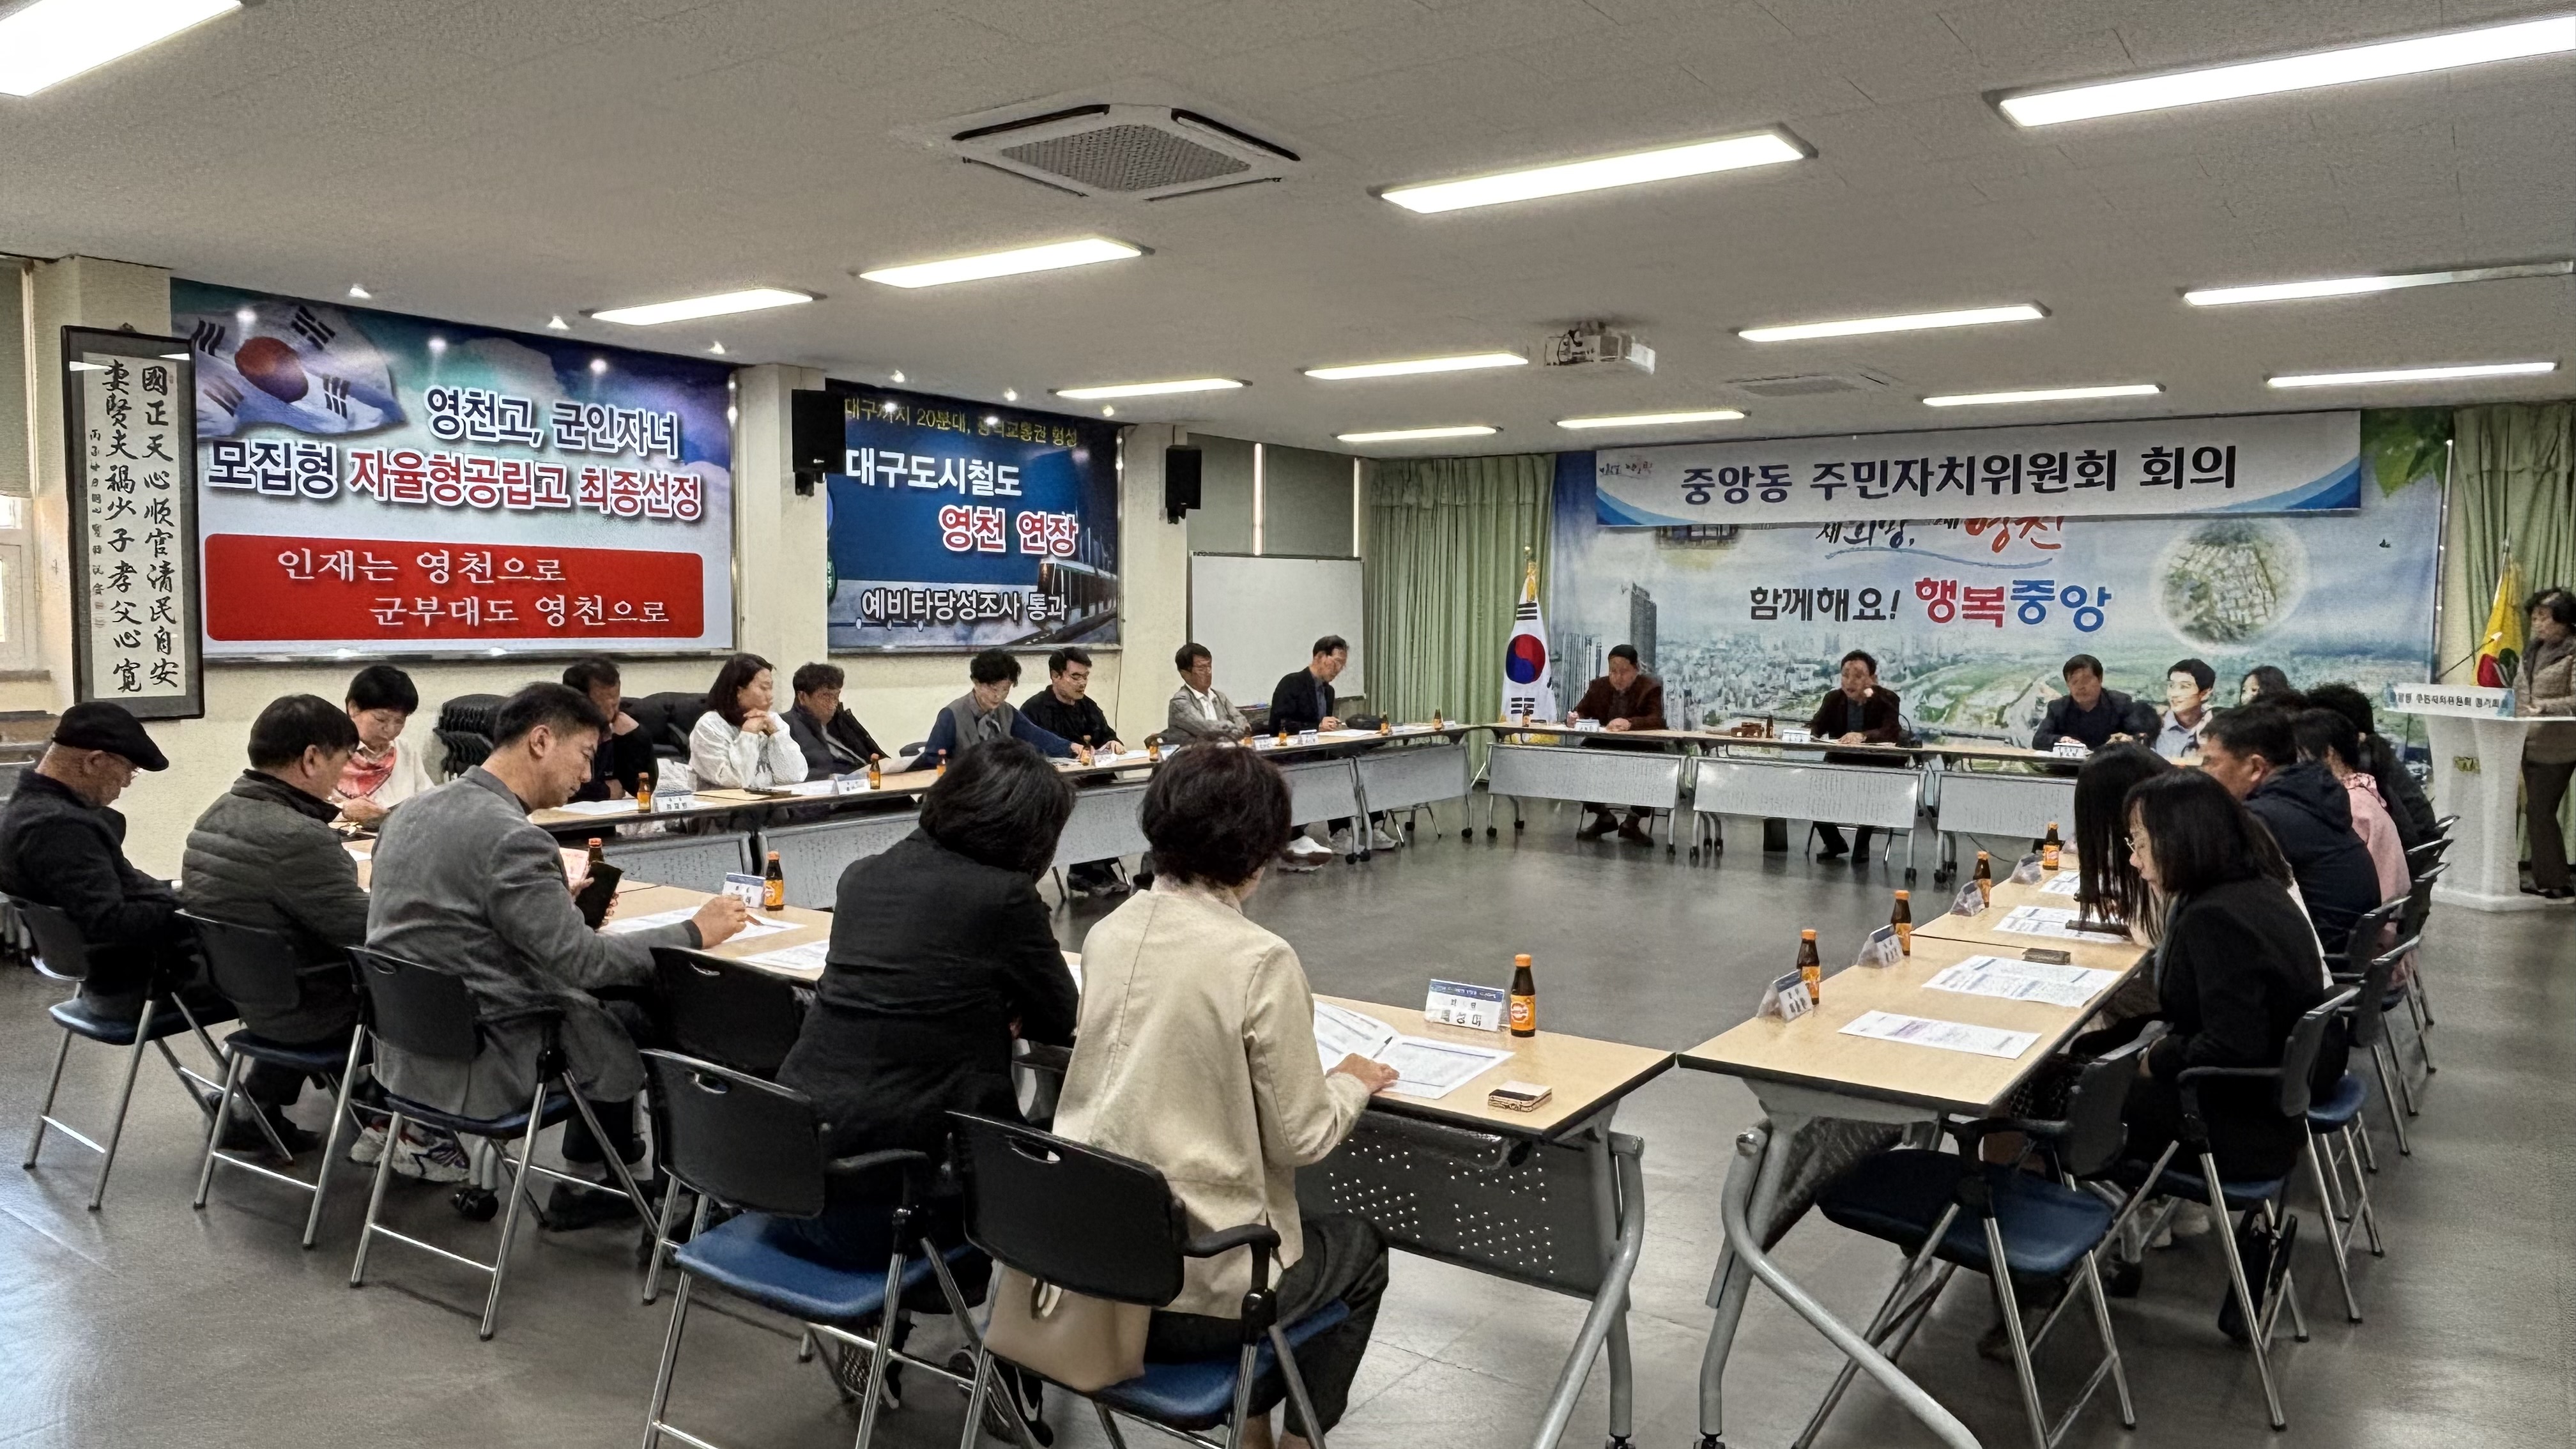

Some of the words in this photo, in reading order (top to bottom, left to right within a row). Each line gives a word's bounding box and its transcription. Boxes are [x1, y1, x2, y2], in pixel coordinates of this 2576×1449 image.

[427, 386, 542, 448] 영천고,
[551, 399, 678, 459] 군인자녀
[206, 440, 337, 498] 모집형
[348, 448, 570, 509] 자율형공립고
[578, 466, 703, 520] 최종선정
[846, 448, 1022, 496] 대구도시철도
[1681, 464, 1793, 505] 중앙동
[1810, 449, 2117, 500] 주민자치위원회
[2140, 445, 2236, 489] 회의
[939, 505, 1006, 552] 영천
[1016, 511, 1078, 556] 연장
[278, 548, 398, 582] 인재는
[416, 549, 566, 584] 영천으로
[369, 596, 518, 627] 군부대도
[535, 595, 669, 627] 영천으로
[861, 588, 1020, 620] 예비타당성조사
[1027, 593, 1067, 620] 통과
[1750, 586, 1901, 622] 함께해요!
[1915, 578, 2112, 632] 행복중앙
